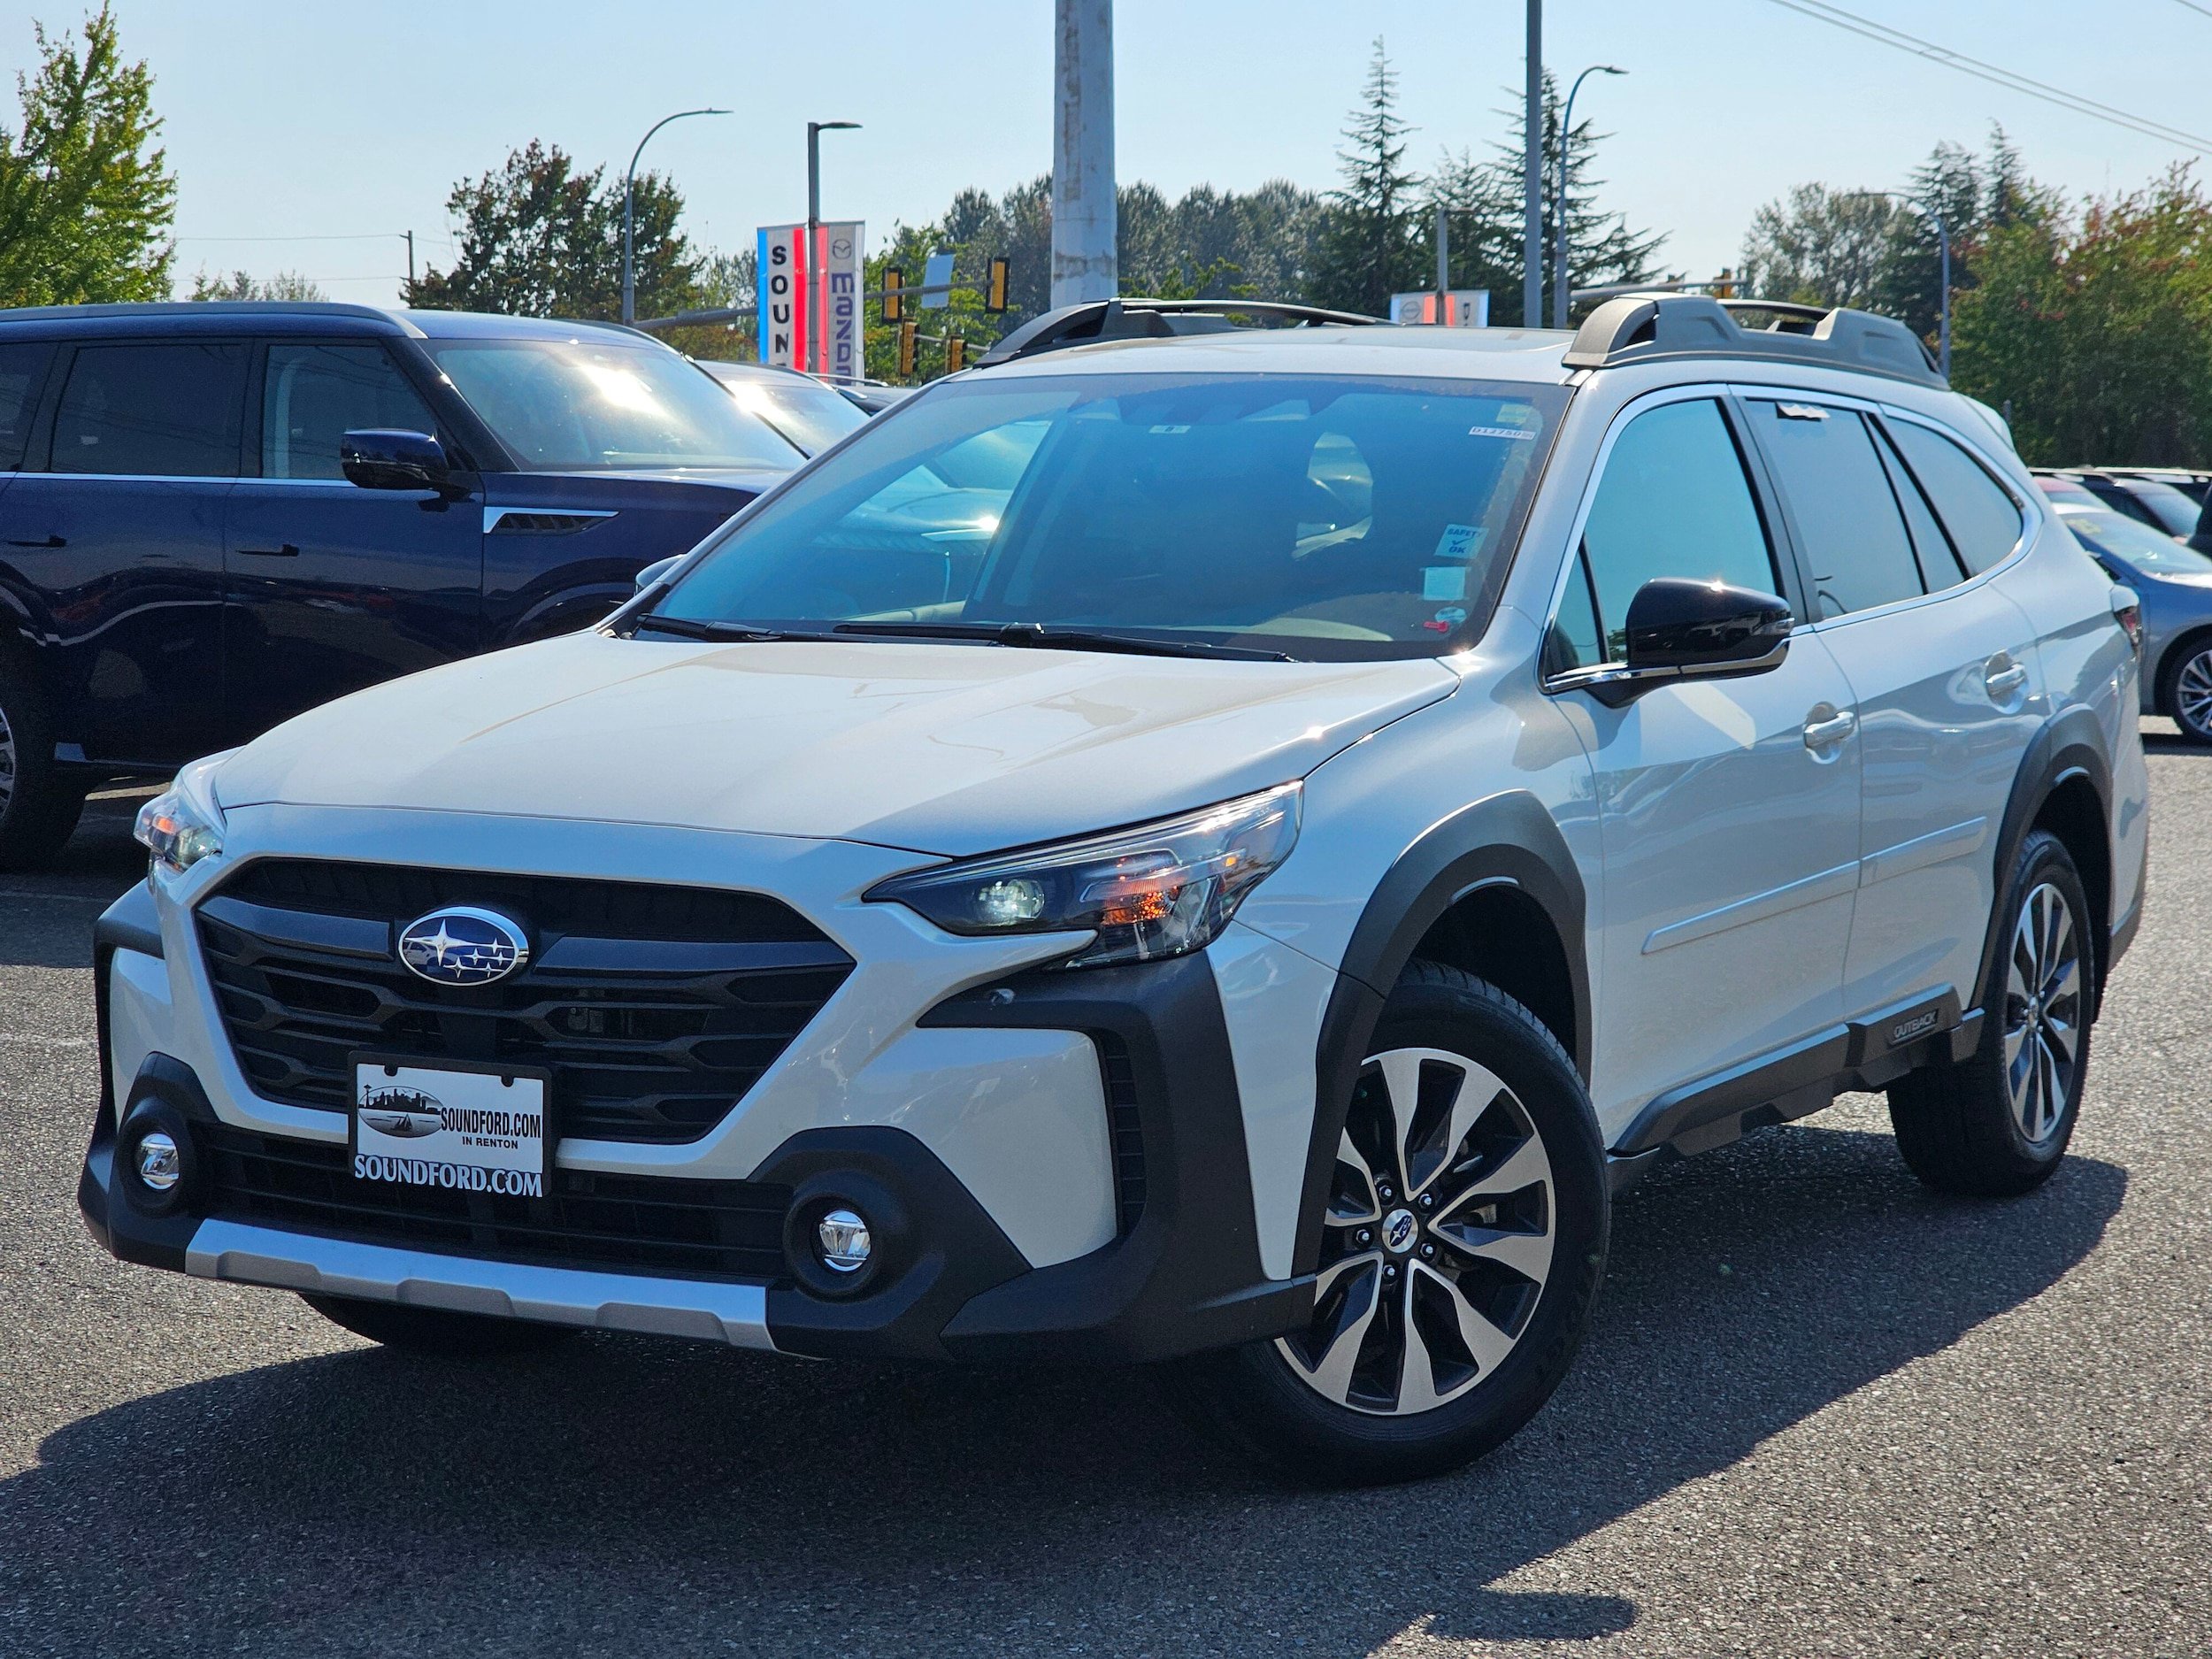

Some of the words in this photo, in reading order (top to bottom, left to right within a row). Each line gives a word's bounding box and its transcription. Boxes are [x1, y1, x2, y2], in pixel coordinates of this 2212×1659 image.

[771, 245, 790, 366] SOUN
[1893, 1010, 1937, 1039] OUTBACK
[441, 1107, 541, 1139] SOUNDFORD.COM
[462, 1136, 472, 1146] IN
[476, 1138, 518, 1149] RENTON
[354, 1154, 542, 1197] SOUNDFORD.COM
